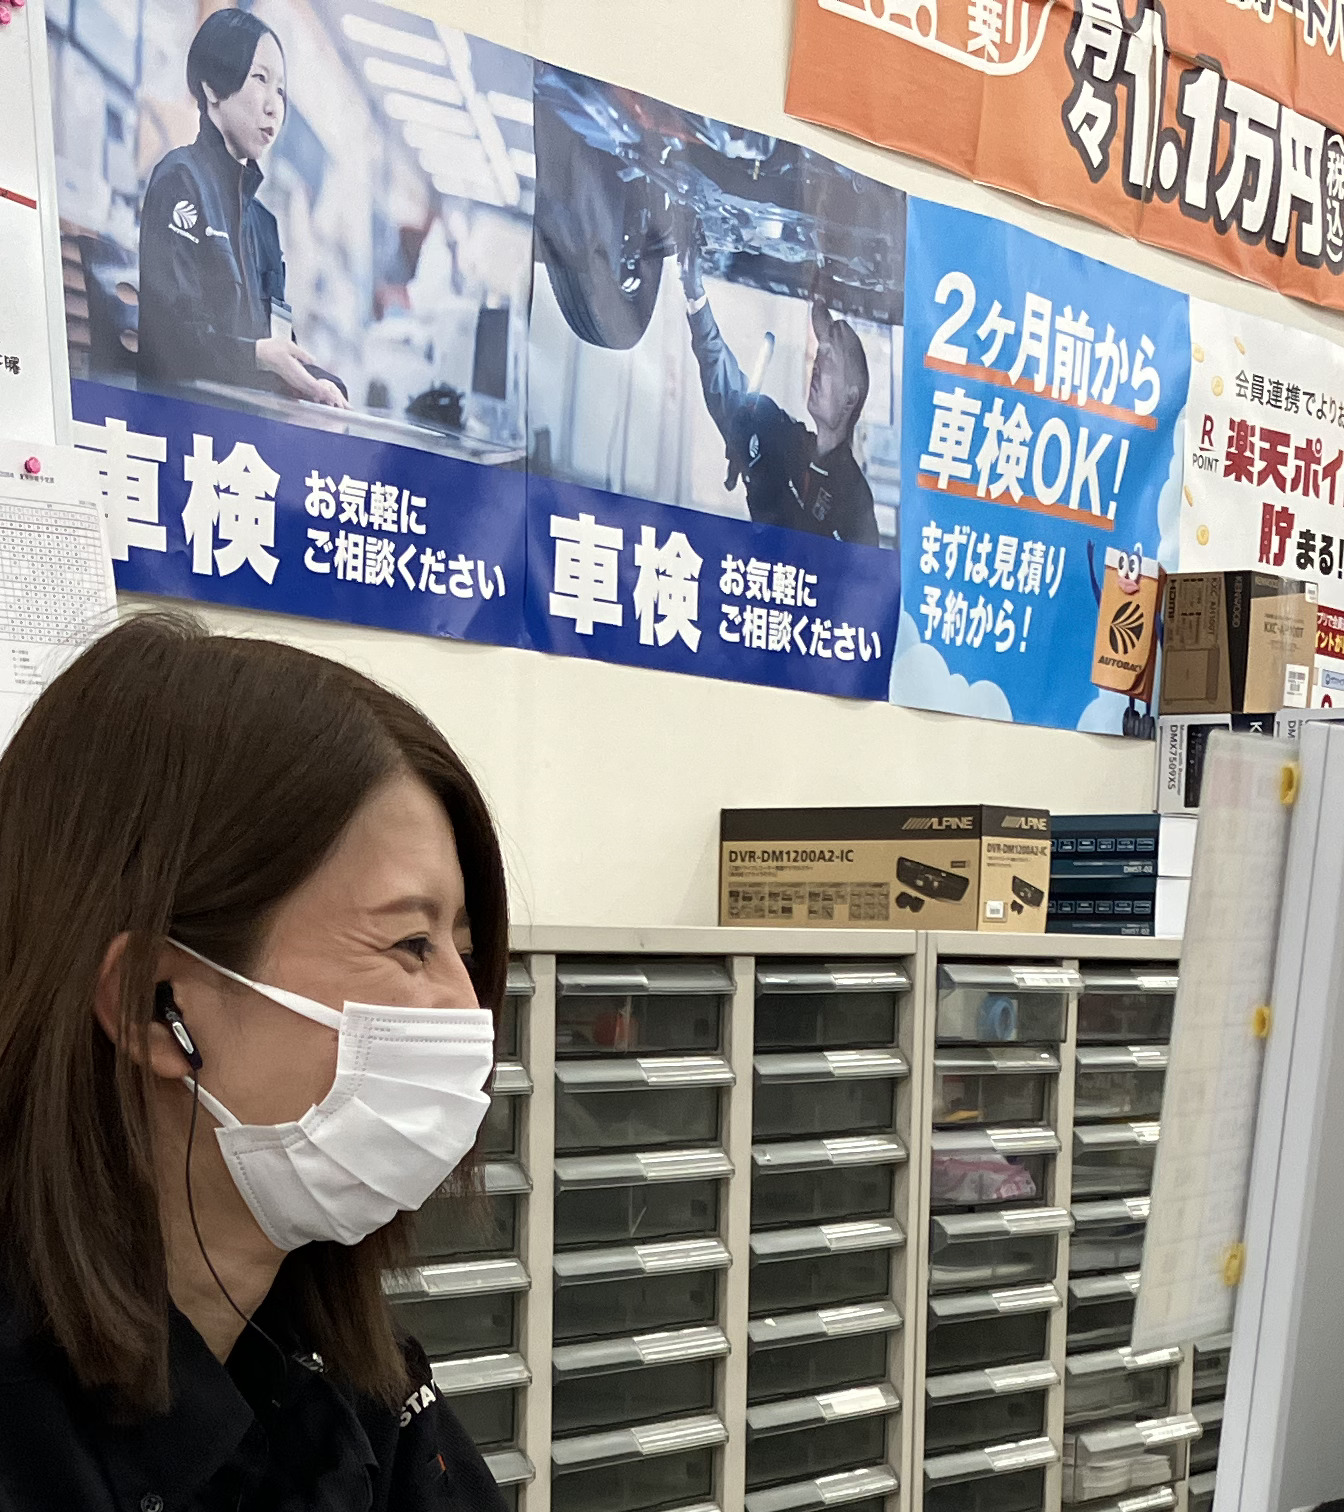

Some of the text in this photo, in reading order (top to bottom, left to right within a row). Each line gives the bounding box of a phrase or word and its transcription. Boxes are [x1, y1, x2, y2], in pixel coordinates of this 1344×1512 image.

[927, 271, 1162, 417] 2ヶ月前から
[919, 386, 1131, 522] 車検OK!
[1192, 452, 1220, 474] POINT
[71, 416, 428, 586] 車検 お気軽に
[303, 529, 507, 601] ご相談ください
[548, 512, 819, 654] 車検 お気軽に
[919, 519, 1066, 598] まずは見積り
[717, 603, 883, 663] ご相談ください
[919, 585, 1033, 654] 予約から!
[728, 848, 856, 864] DVR-DM1200A2-IC
[928, 814, 975, 831] ALPINE
[1018, 814, 1049, 832] ALPINE
